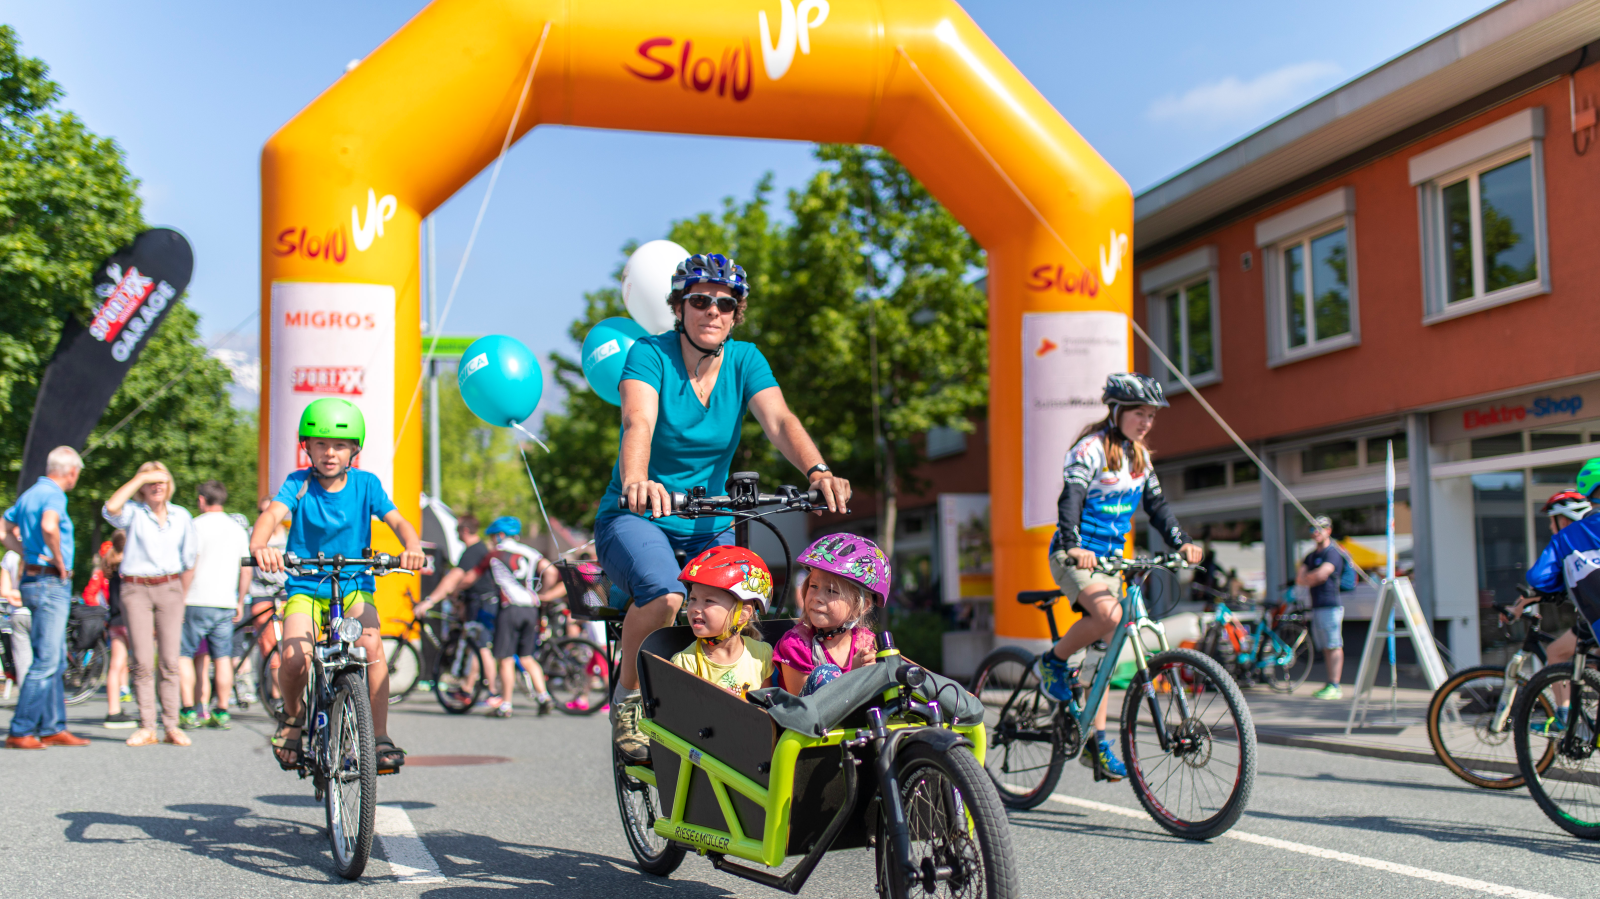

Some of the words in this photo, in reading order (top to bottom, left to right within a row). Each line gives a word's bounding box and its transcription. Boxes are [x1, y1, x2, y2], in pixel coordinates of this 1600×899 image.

[111, 280, 176, 362] GARAGE
[284, 311, 376, 330] MIGROS
[1463, 396, 1582, 429] Elektro-Shop
